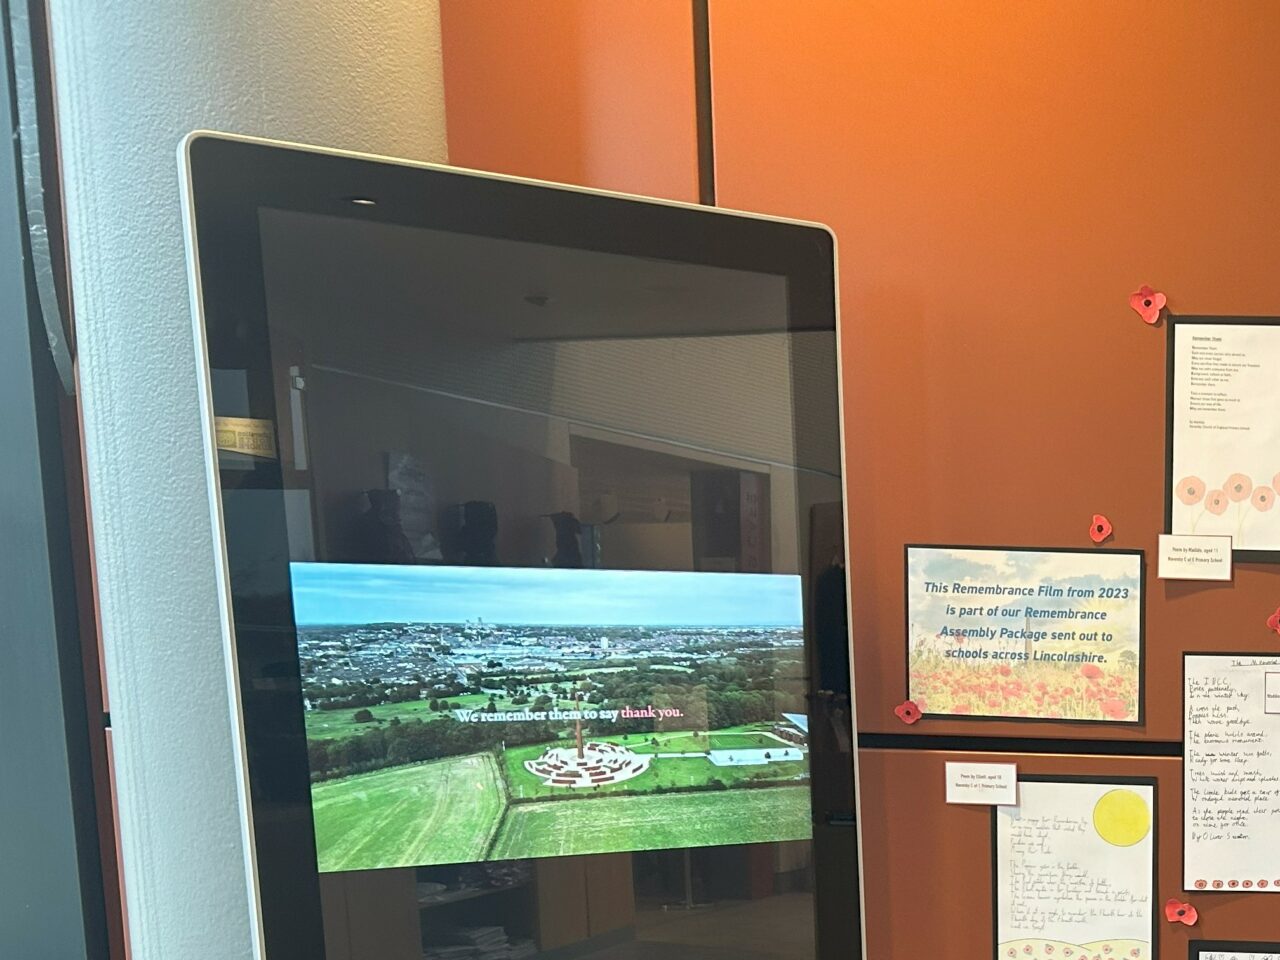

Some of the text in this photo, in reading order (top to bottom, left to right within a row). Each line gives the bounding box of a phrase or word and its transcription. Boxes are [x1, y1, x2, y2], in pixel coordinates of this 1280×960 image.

[924, 581, 1129, 600] This Remembrance Film from 2023
[946, 604, 1107, 620] is part of our Remembrance
[940, 626, 1113, 642] Assembly Package sent out to
[944, 648, 1108, 664] schools across Lincolnshire.
[456, 704, 684, 723] We remember them to say thank you.
